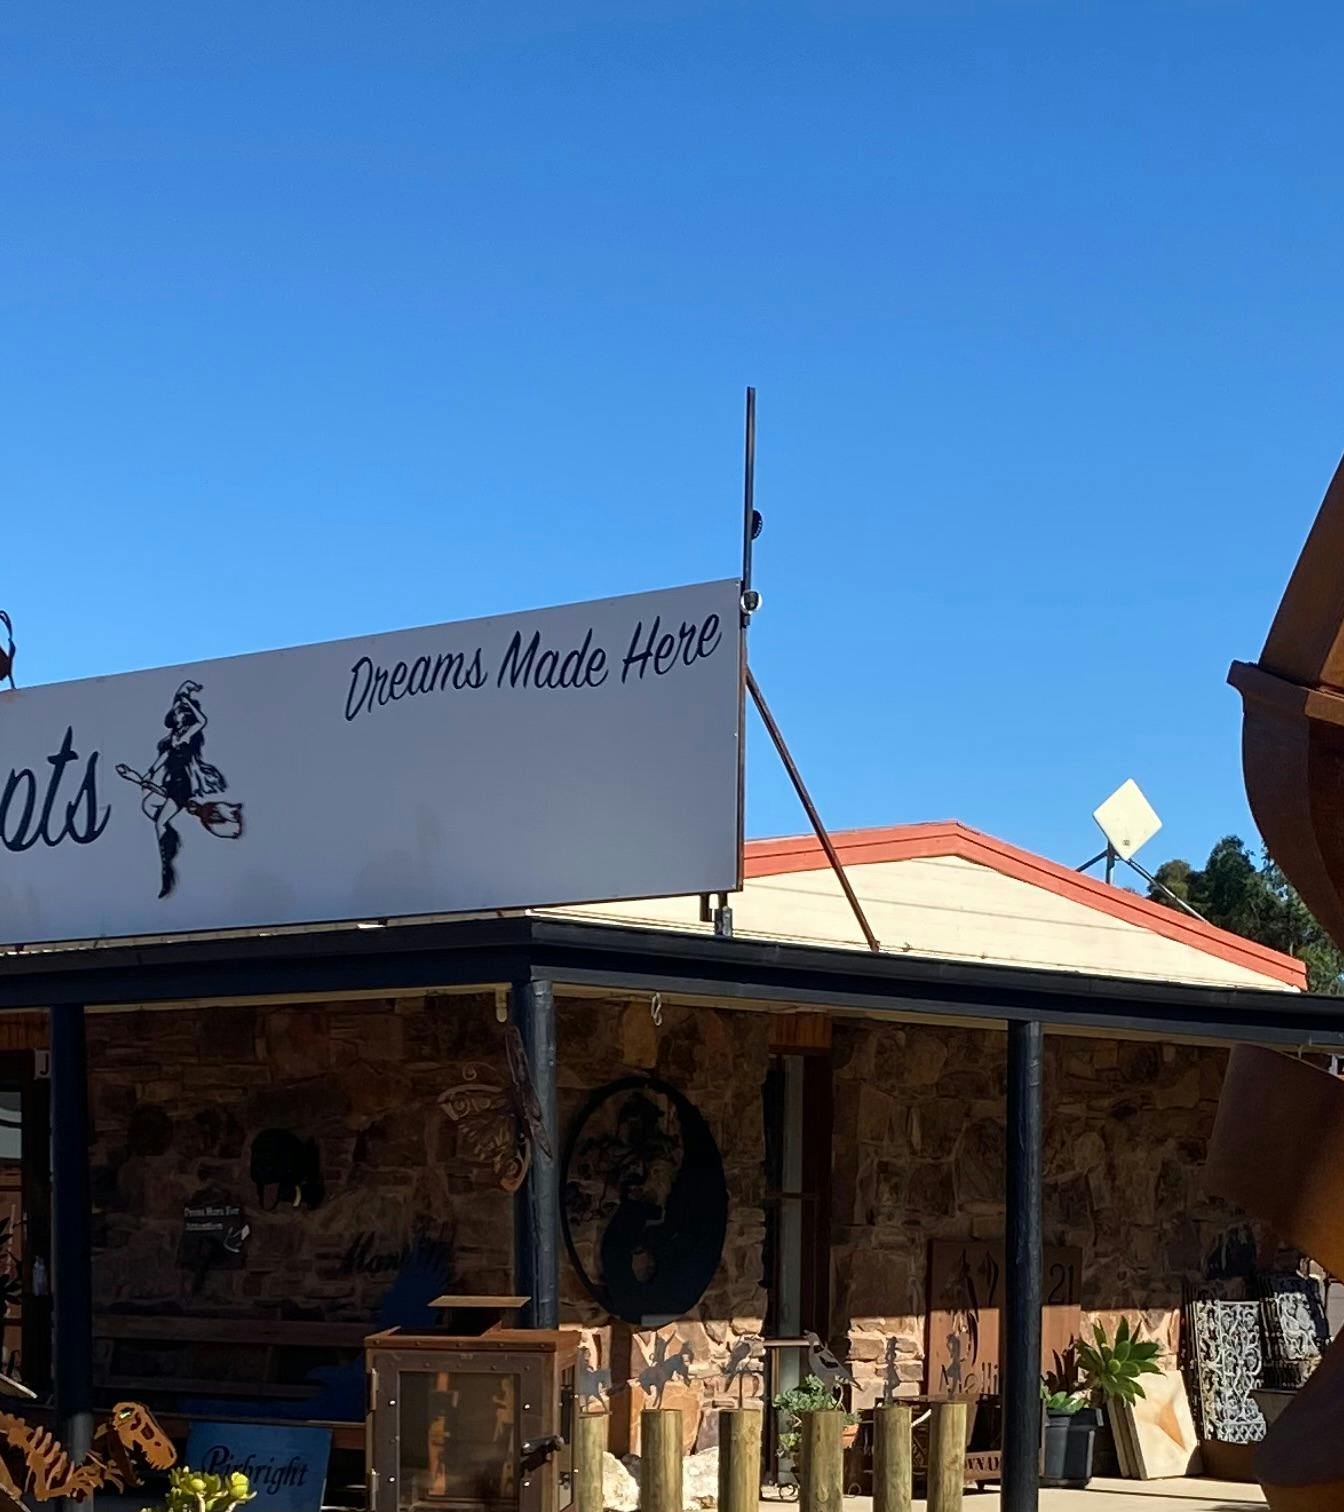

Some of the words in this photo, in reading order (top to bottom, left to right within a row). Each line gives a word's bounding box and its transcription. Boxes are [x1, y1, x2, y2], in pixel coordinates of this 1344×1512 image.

[345, 647, 488, 721] Dreams
[497, 628, 608, 689] Made
[621, 613, 722, 684] Here
[1047, 1263, 1074, 1305] 21
